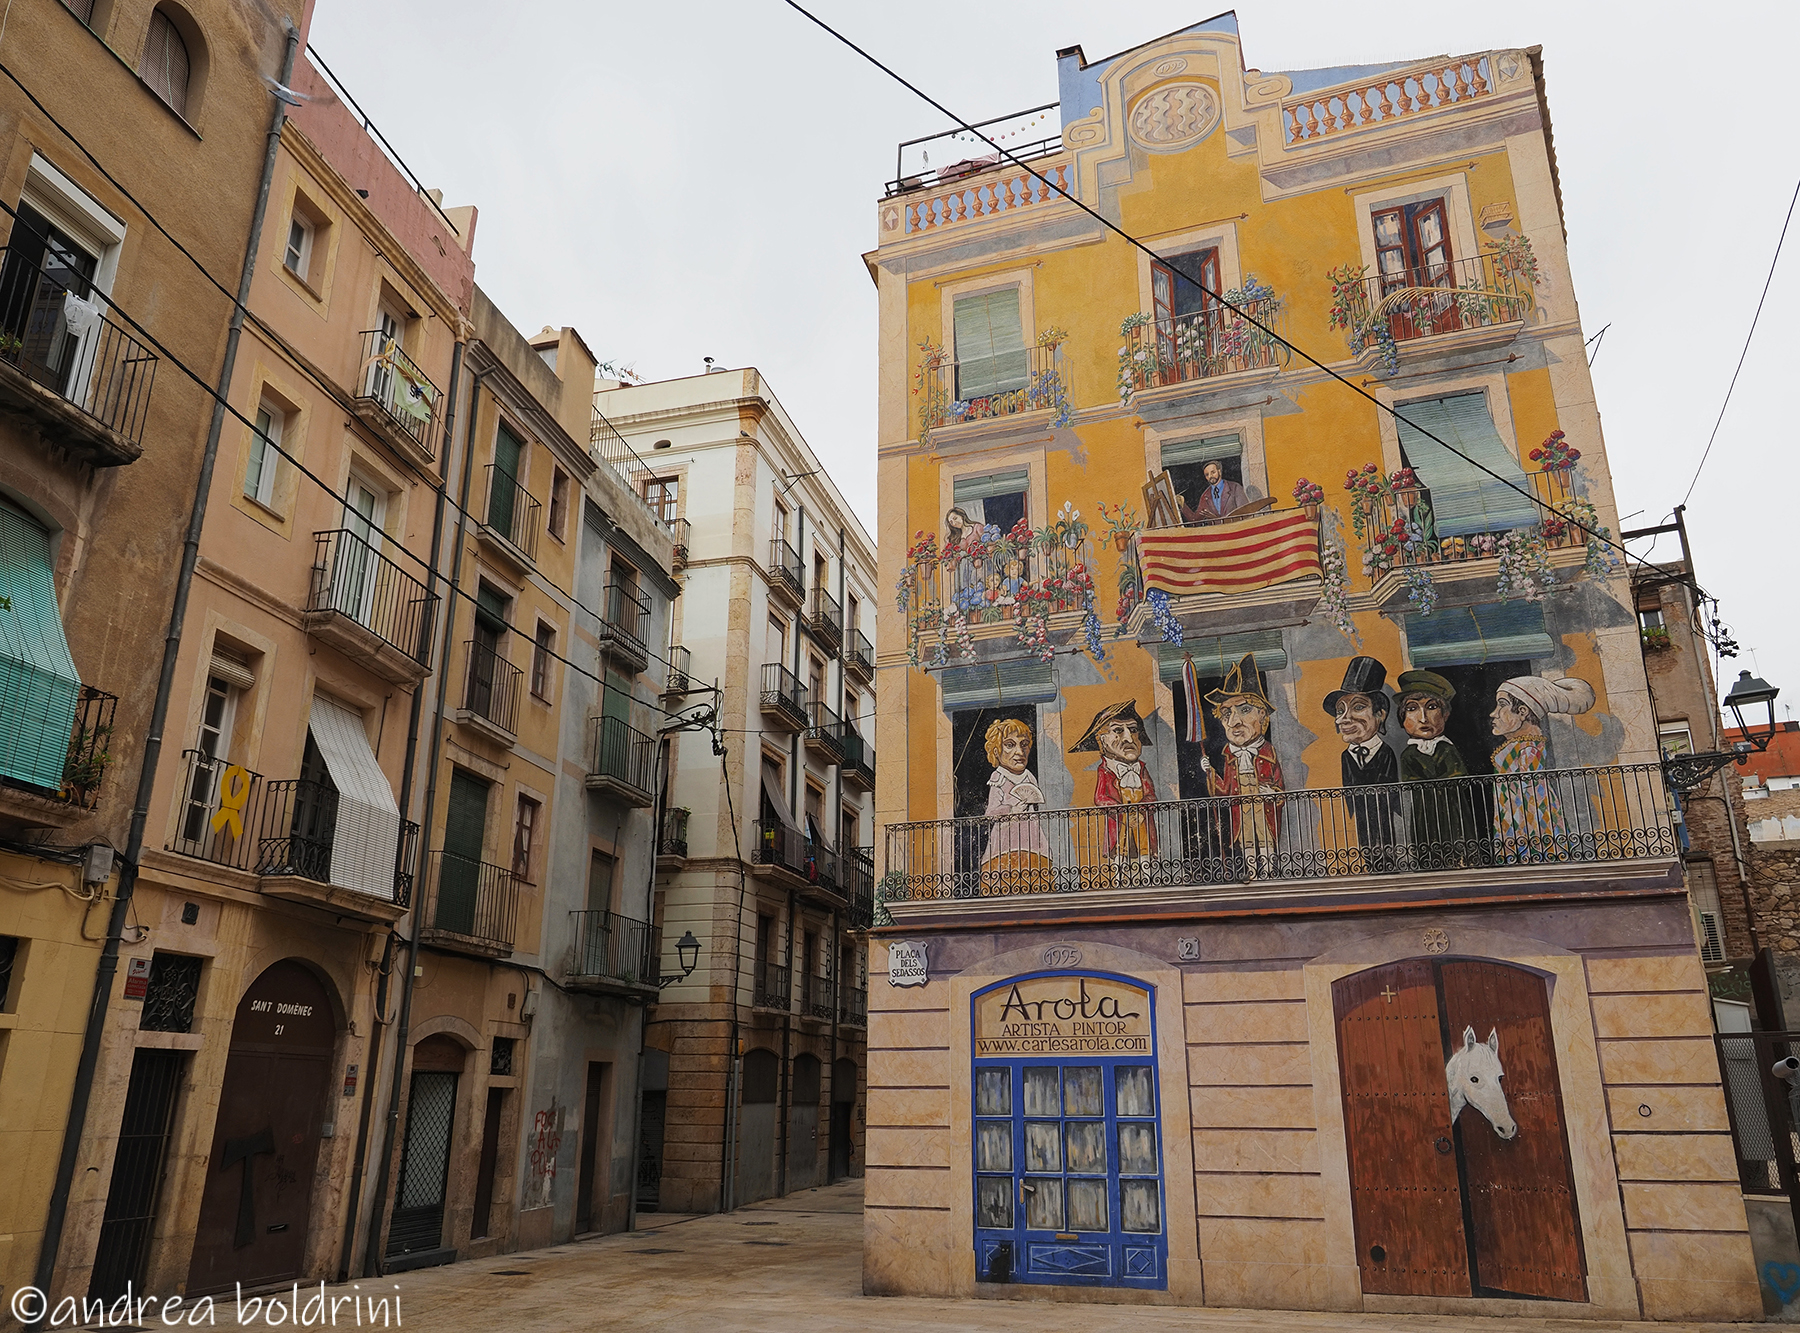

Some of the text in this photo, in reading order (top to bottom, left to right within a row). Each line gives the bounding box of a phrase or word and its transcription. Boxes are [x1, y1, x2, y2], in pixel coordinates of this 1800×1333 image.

[895, 950, 921, 959] PLAÇA
[1185, 943, 1193, 955] 2
[900, 959, 918, 968] DELS
[1046, 950, 1078, 965] 1995
[891, 968, 926, 977] SEDASSOS
[1000, 978, 1140, 1022] Arola
[251, 1000, 313, 1017] SANT DOMÈNEC
[274, 1024, 285, 1036] 21
[1002, 1021, 1129, 1037] ARTISTA PINTOR
[978, 1037, 1147, 1052] www.carlesarola.com
